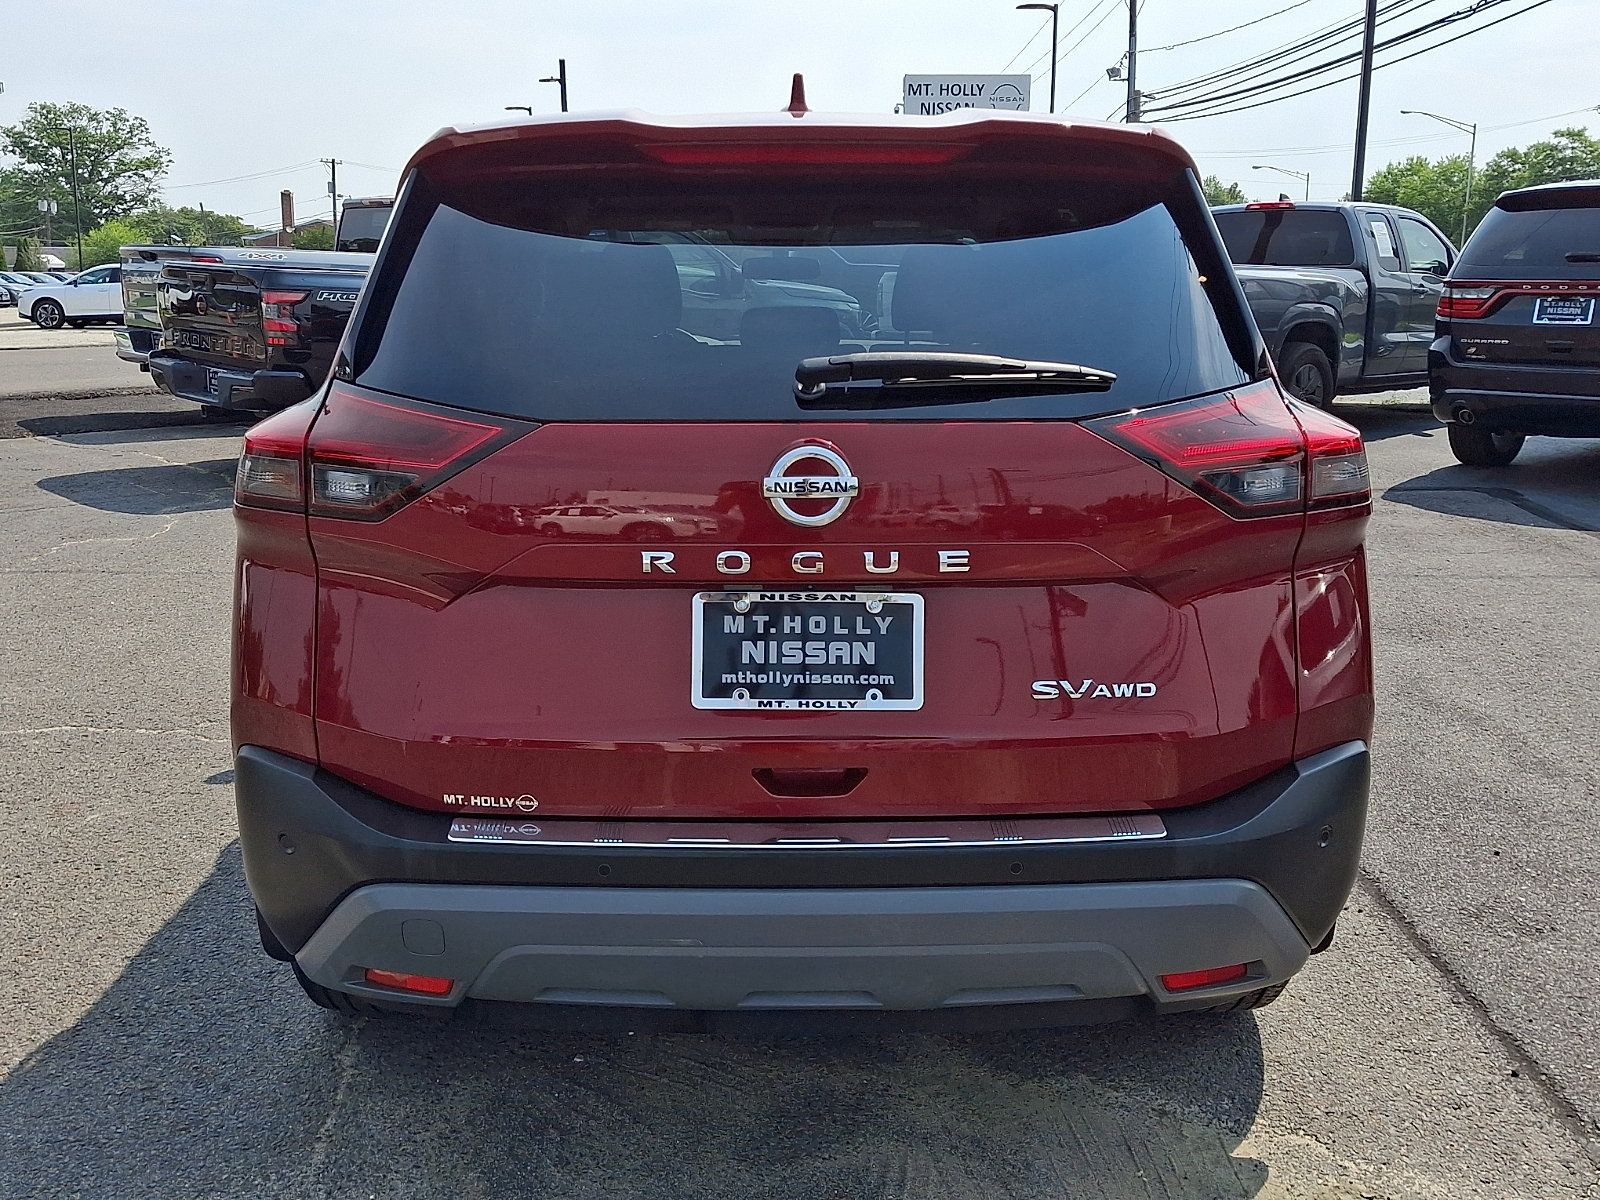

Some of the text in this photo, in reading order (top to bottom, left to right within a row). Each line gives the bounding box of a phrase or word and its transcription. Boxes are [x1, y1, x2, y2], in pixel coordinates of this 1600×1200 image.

[908, 83, 986, 97] MT. HOLLY
[774, 481, 848, 493] NISSAN
[641, 551, 971, 574] ROGUE
[759, 593, 856, 601] NISSAN
[783, 616, 894, 635] HOLLY
[741, 641, 876, 665] NISSAN
[721, 671, 895, 686] mthollynissan.com
[757, 701, 859, 709] MT. HOLLY
[443, 794, 515, 808] MT. HOLLY
